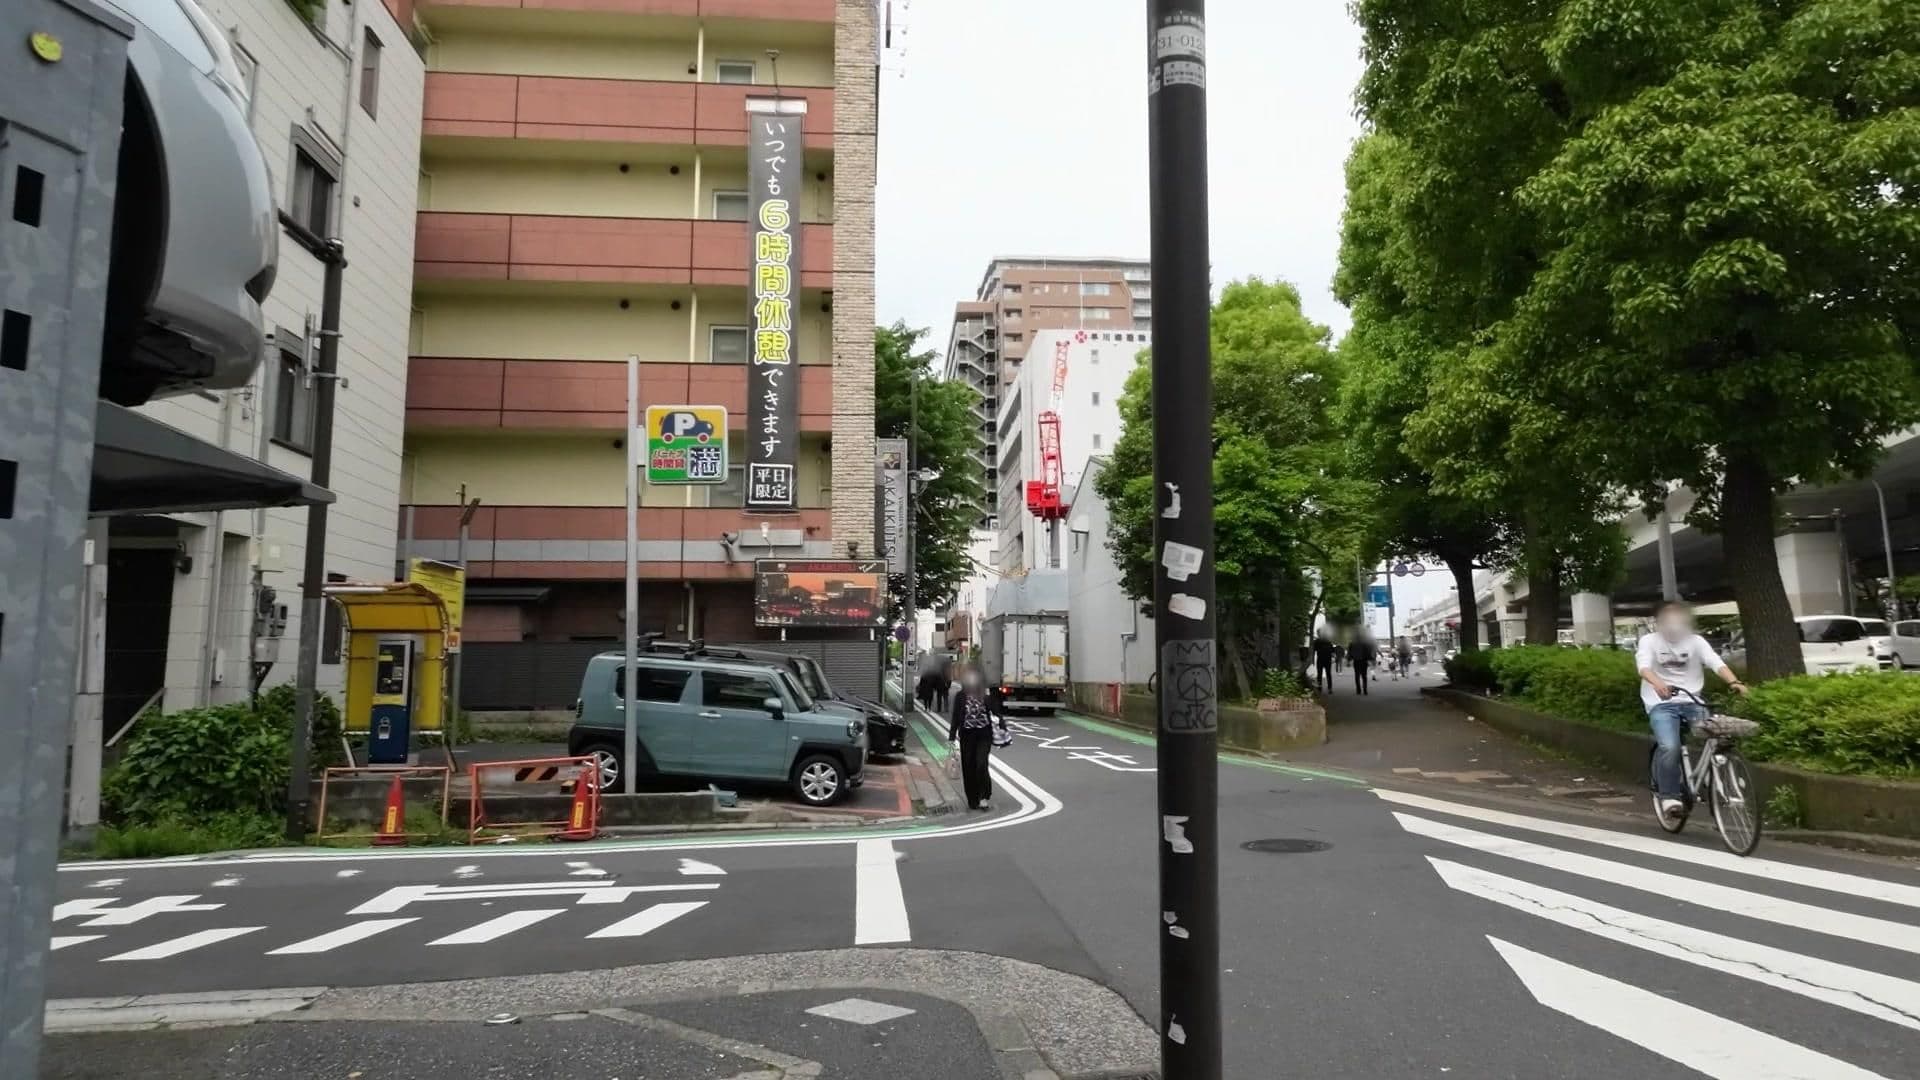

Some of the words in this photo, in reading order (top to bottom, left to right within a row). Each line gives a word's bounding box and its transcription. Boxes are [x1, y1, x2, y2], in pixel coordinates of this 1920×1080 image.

[674, 413, 696, 436] P
[755, 469, 785, 483] 平日
[755, 484, 787, 499] 限定
